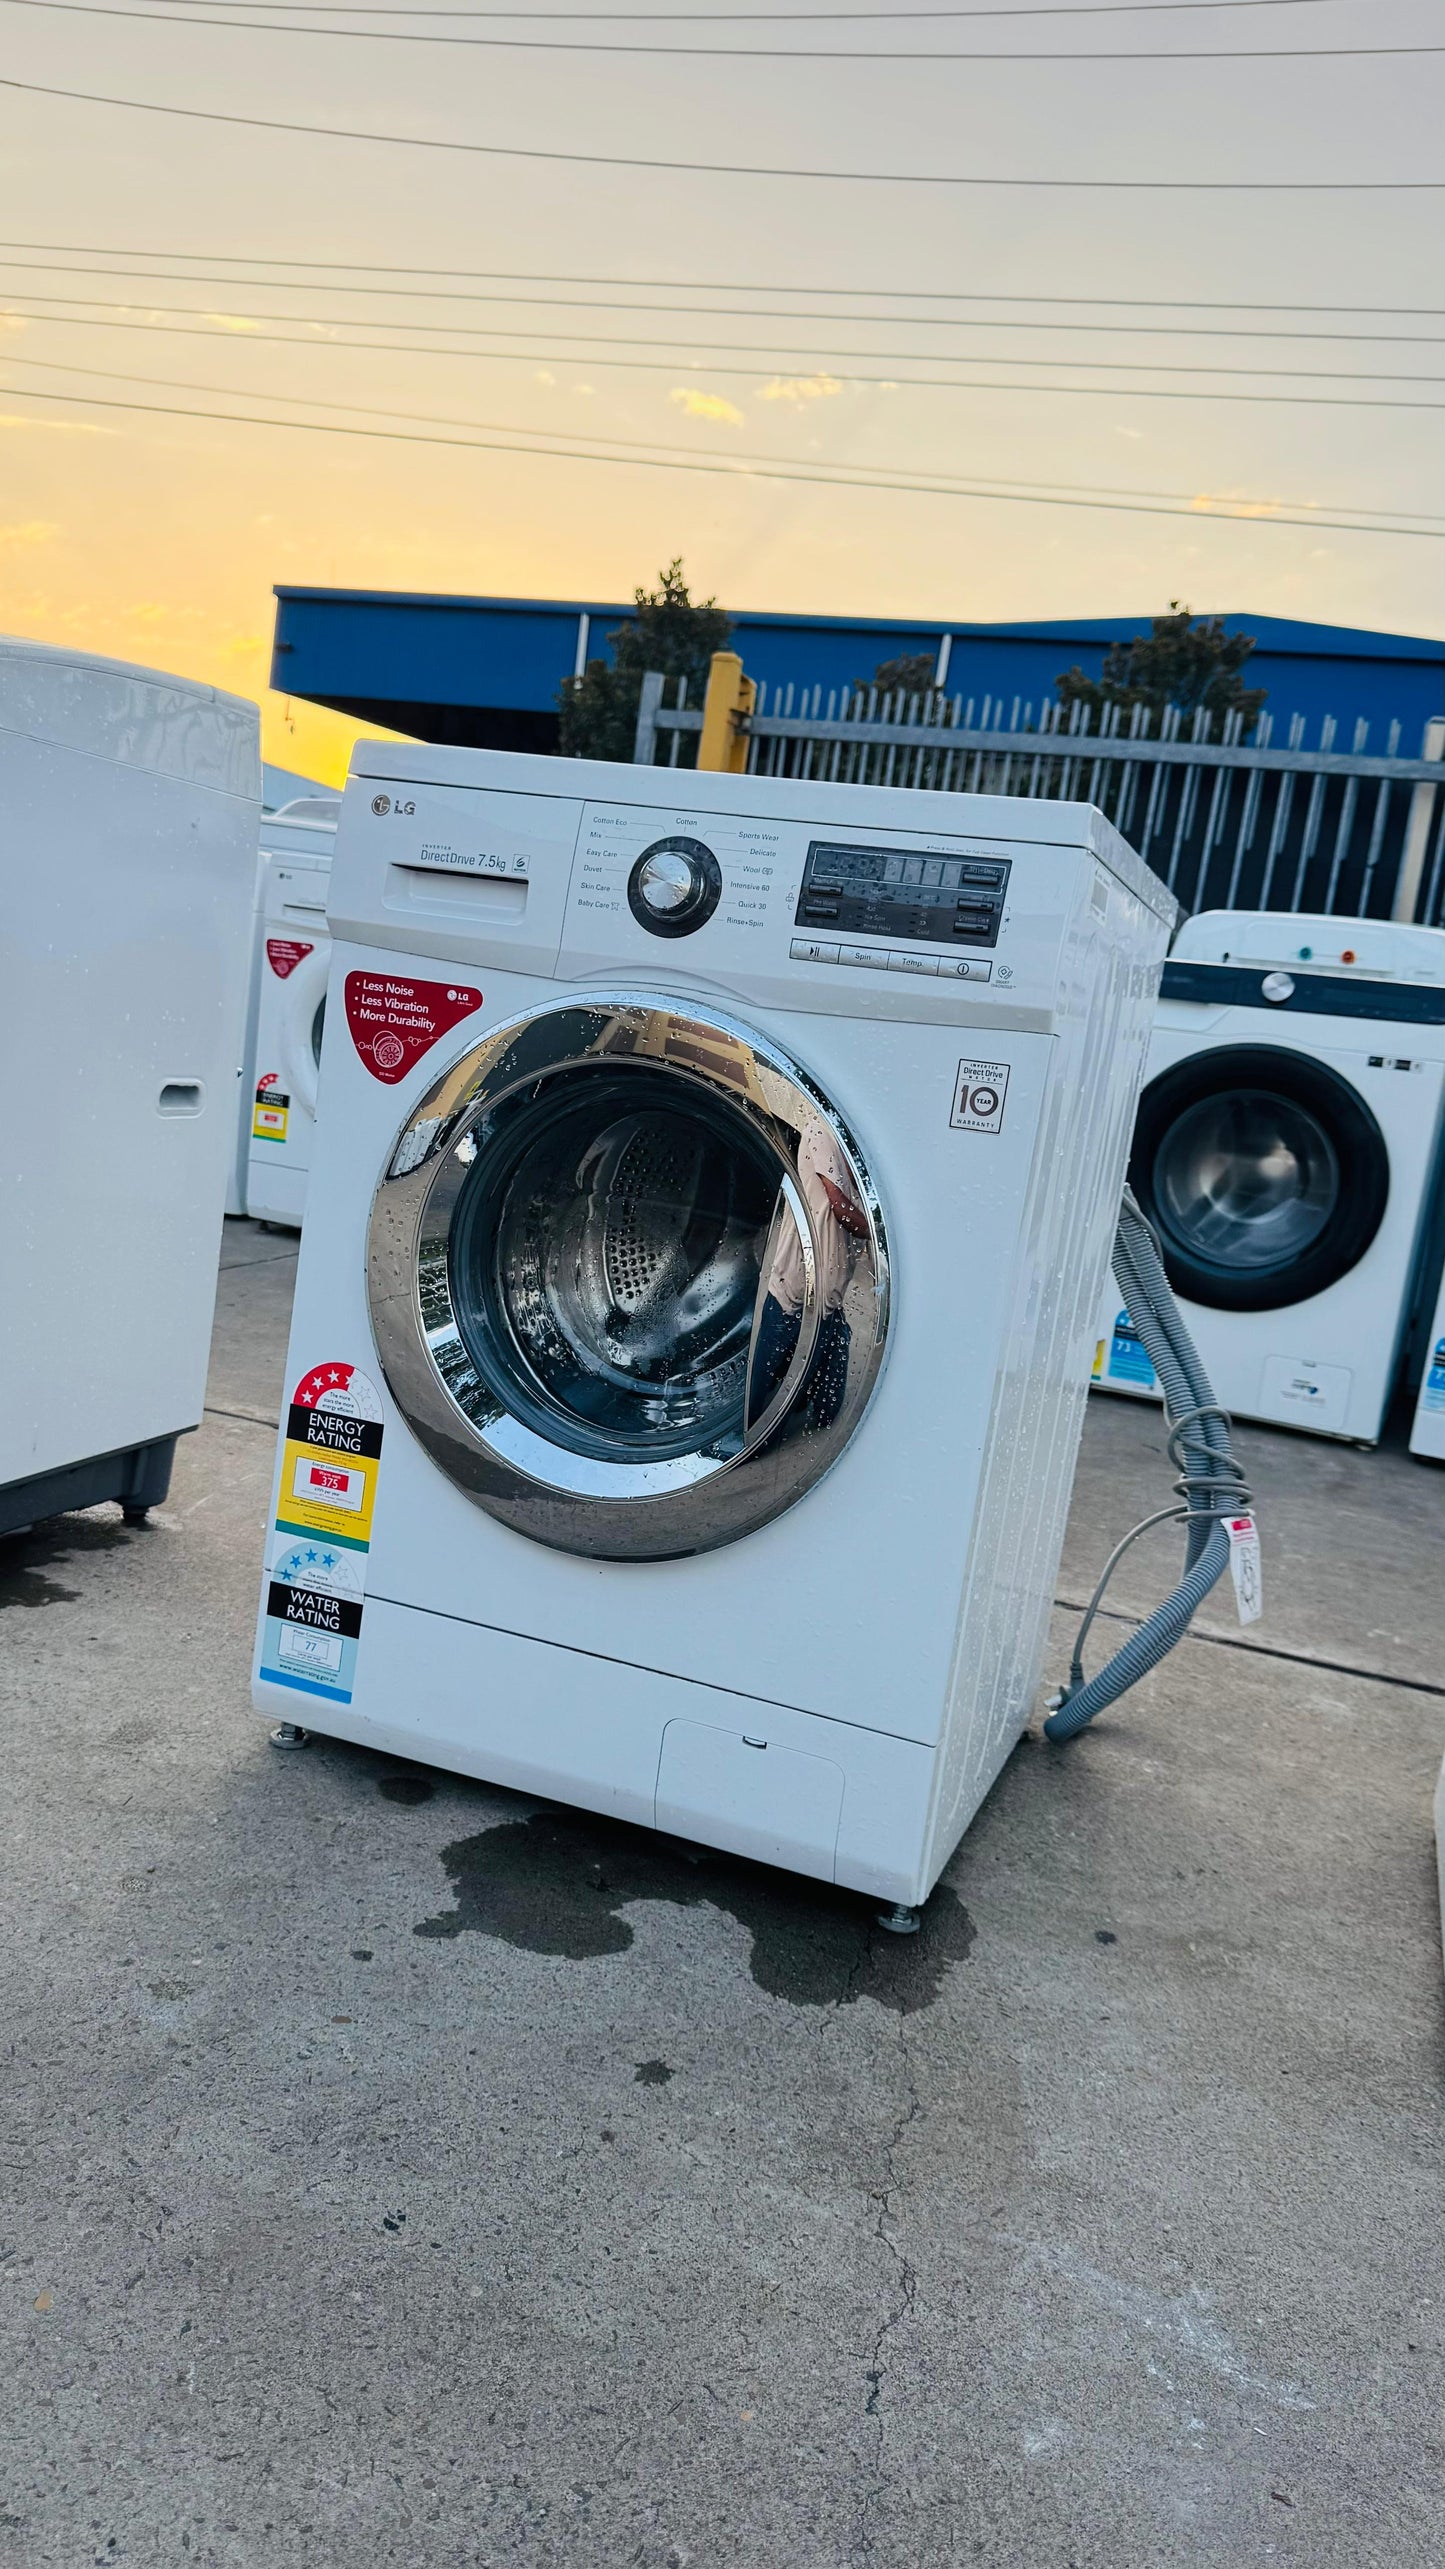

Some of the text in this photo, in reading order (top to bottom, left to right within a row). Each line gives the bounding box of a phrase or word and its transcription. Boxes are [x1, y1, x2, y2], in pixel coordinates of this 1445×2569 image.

[393, 799, 416, 816] LG
[593, 816, 614, 825] Cotton
[676, 817, 698, 826] Cotton
[590, 831, 602, 839] Mix
[738, 831, 780, 842] Sports Wear
[422, 843, 452, 851] INVERTER
[586, 848, 618, 858] Easy Care
[750, 848, 777, 858] Delicate
[583, 864, 603, 874] Duvet
[743, 866, 761, 874] Wool
[580, 882, 611, 892] Skin Care
[730, 881, 770, 892] Intensive 60
[578, 898, 610, 910] Baby Care
[738, 900, 767, 910] Quick 30
[854, 952, 872, 962] Spin
[362, 980, 414, 997] Less Noise
[457, 992, 469, 1002] LG
[361, 994, 429, 1014] Less Vibration
[360, 1008, 436, 1032] More Durability
[960, 1084, 999, 1117] 10
[976, 1098, 992, 1106] YEAR
[957, 1119, 994, 1128] WARRANTY
[309, 1412, 366, 1437] ENERGY
[307, 1428, 362, 1452] RATING
[322, 1476, 338, 1488] 375
[290, 1590, 340, 1614] WATER
[286, 1604, 340, 1630] RATING
[306, 1640, 317, 1652] 77
